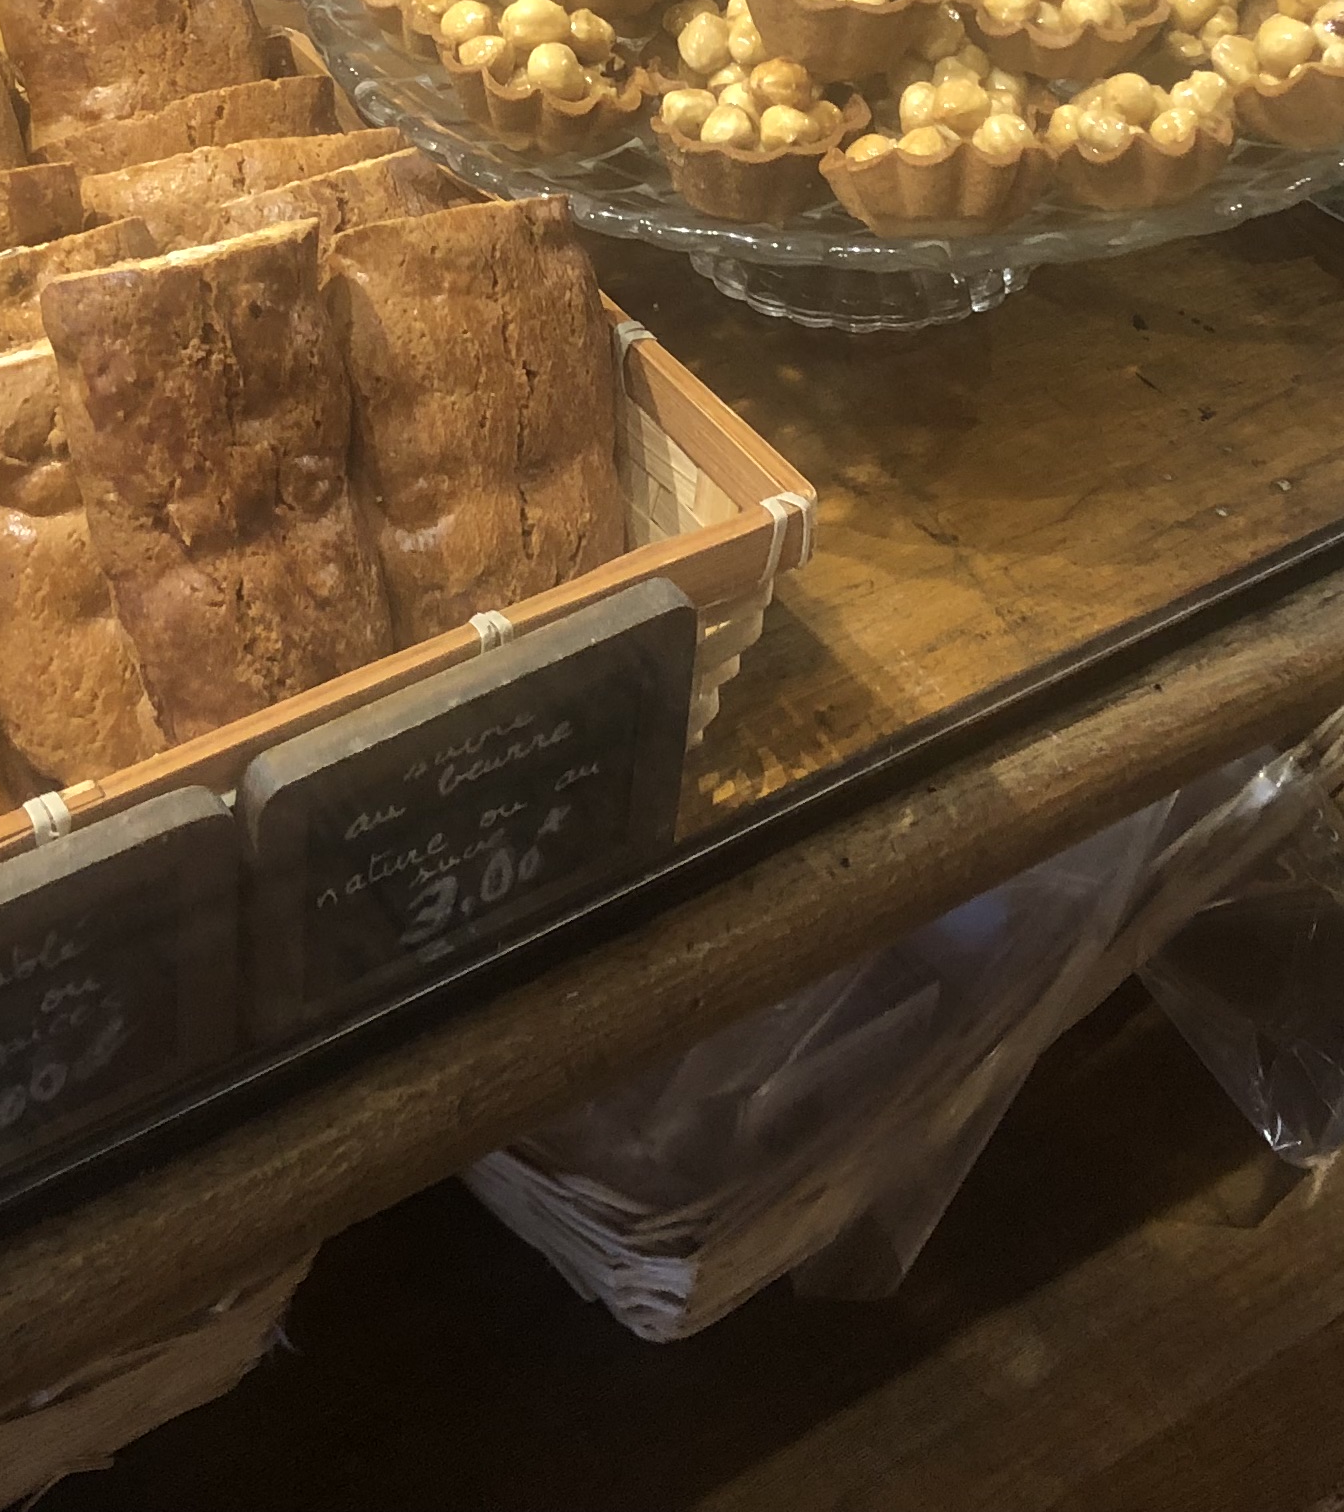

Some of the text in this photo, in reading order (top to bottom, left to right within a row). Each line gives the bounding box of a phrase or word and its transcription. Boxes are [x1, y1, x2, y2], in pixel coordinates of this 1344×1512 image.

[317, 760, 601, 909] nature ou au
[344, 720, 574, 840] au beurre
